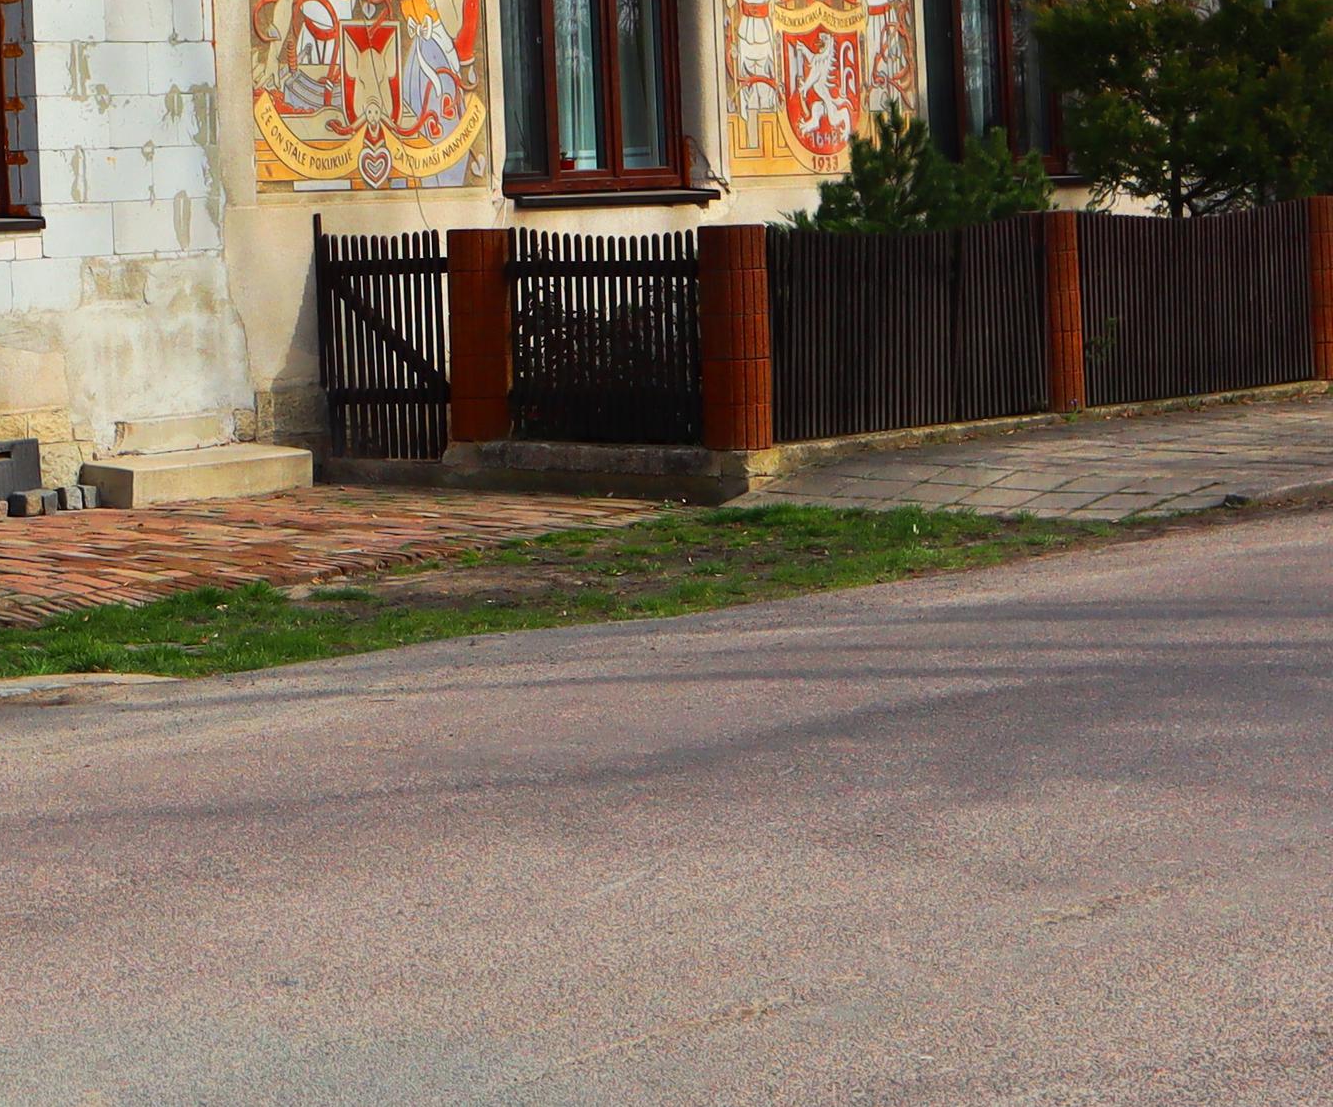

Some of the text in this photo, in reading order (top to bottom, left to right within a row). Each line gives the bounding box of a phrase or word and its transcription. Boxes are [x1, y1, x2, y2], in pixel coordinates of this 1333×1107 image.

[261, 105, 272, 126] ŽE
[271, 125, 284, 144] ON
[283, 140, 306, 166] STÁLE
[812, 155, 839, 172] 1933
